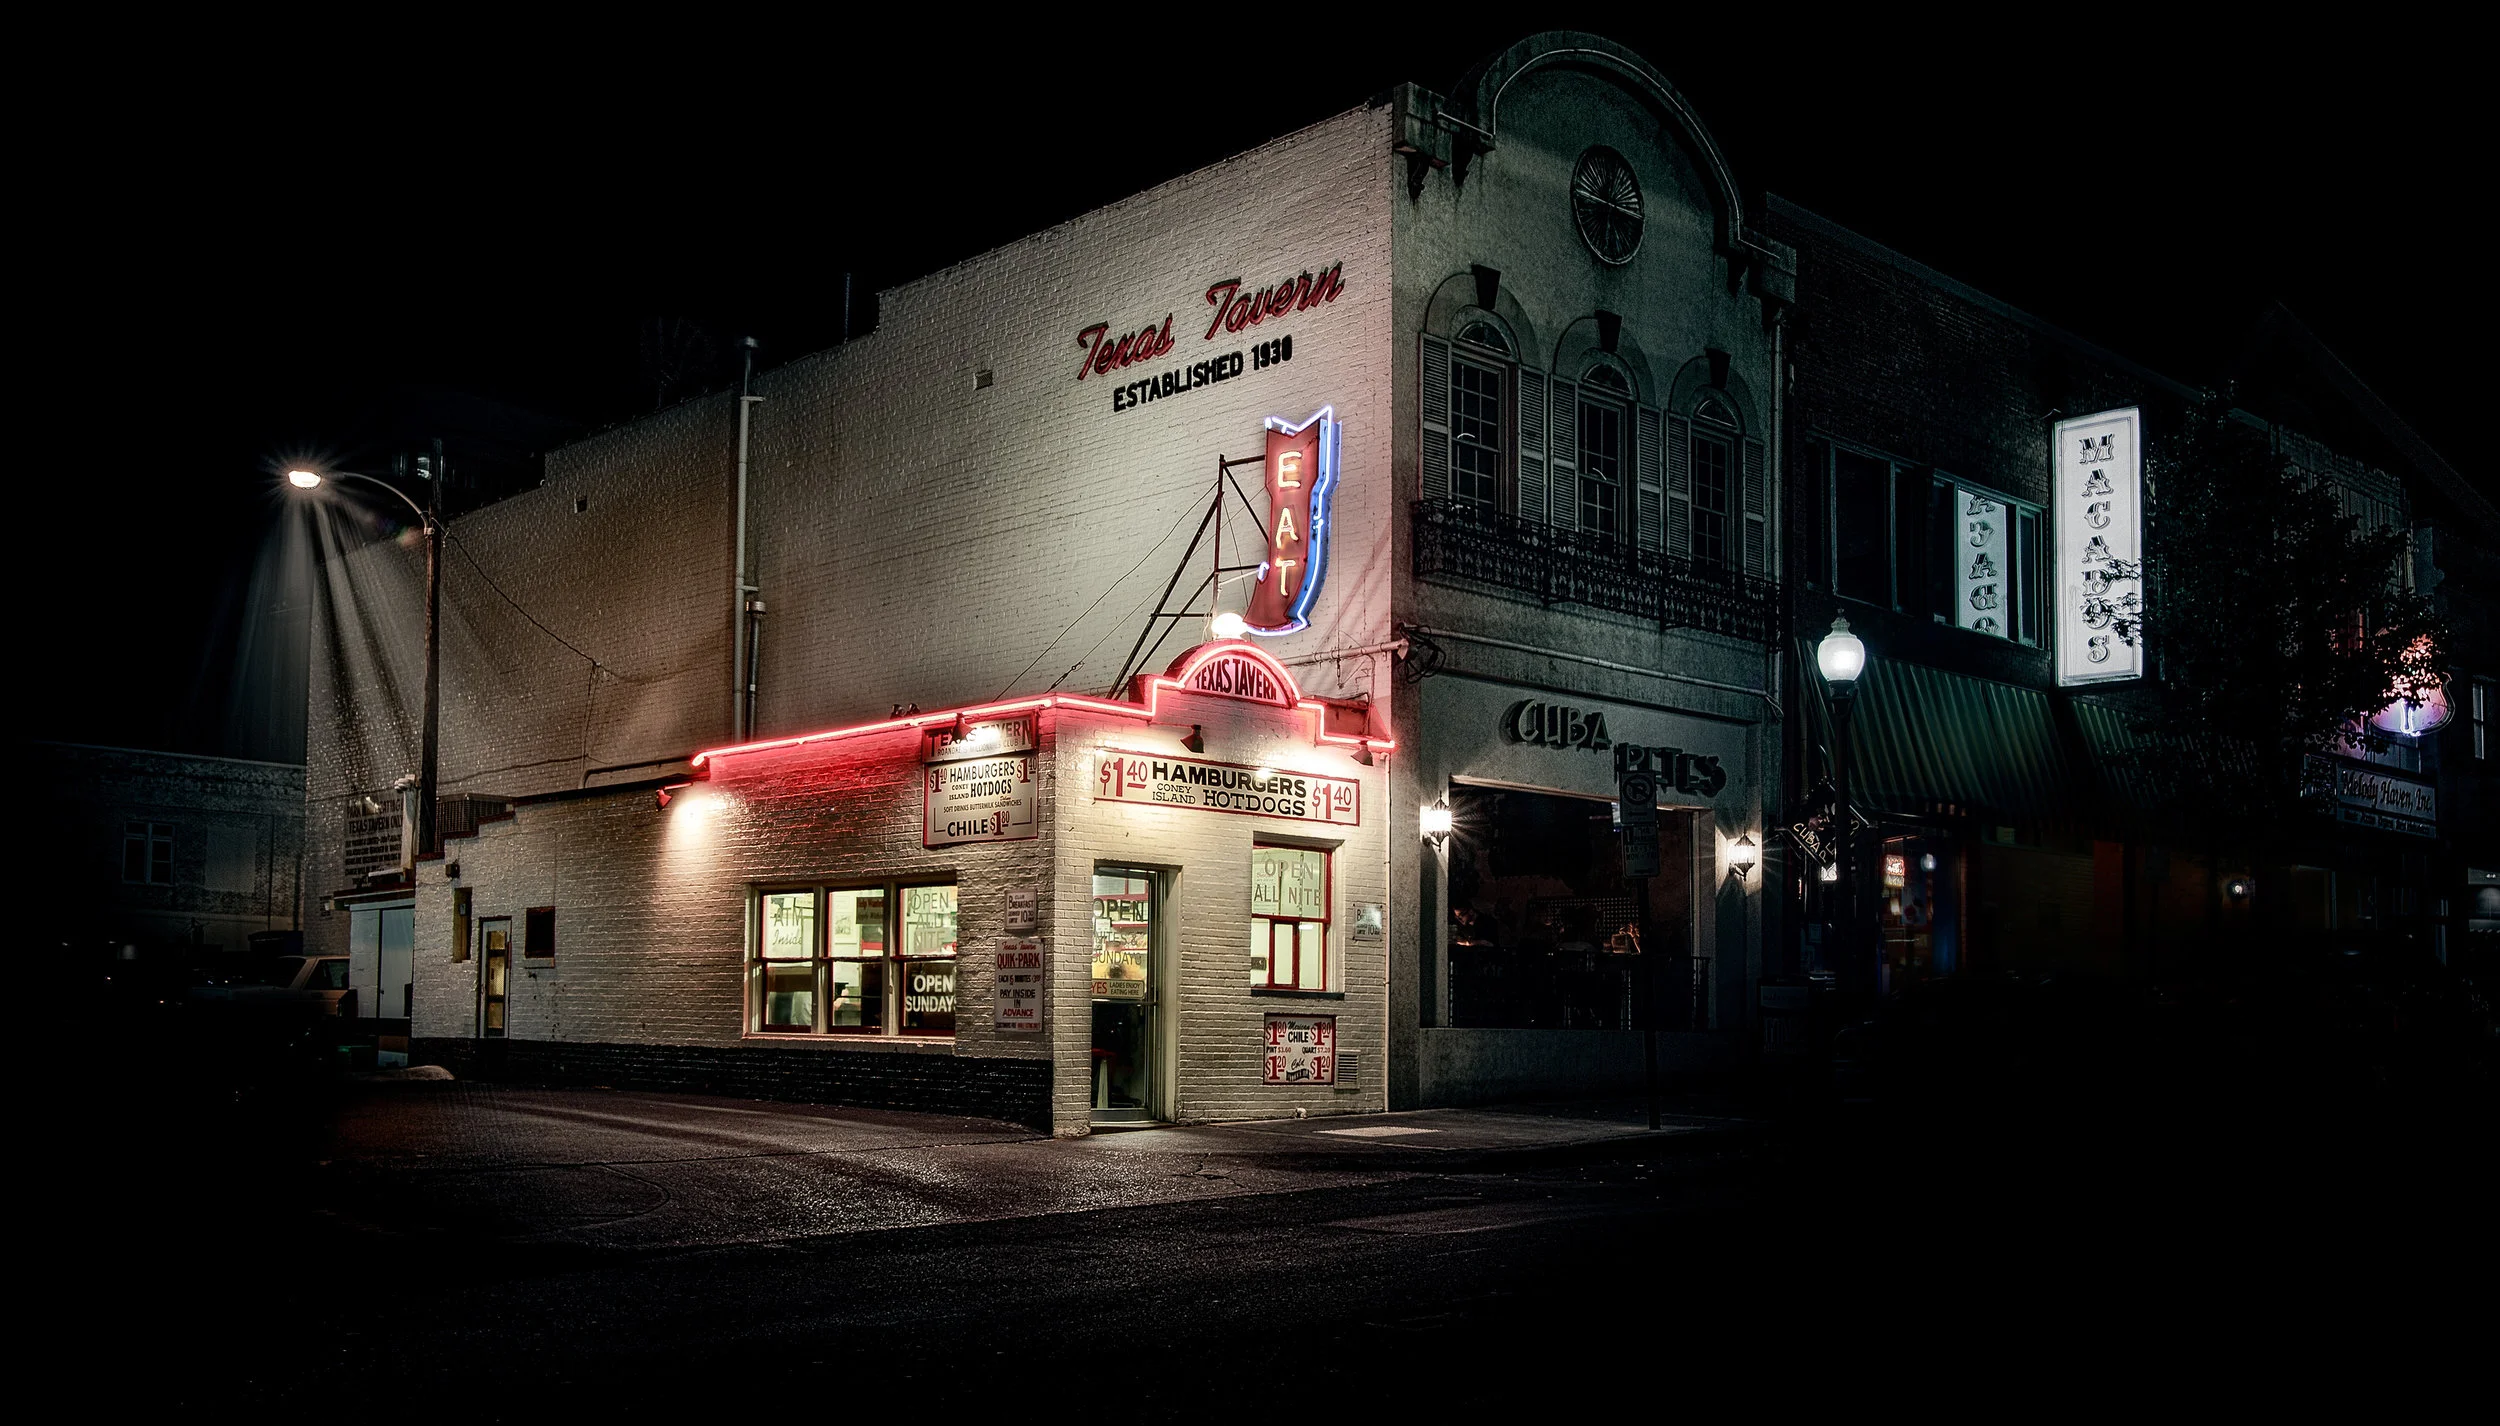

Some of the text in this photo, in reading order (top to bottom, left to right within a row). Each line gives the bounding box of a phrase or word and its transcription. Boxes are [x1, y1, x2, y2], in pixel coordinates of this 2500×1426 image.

[1077, 260, 1345, 380] Texas Tavern
[1113, 334, 1293, 412] ESTABLISHED 1930
[1275, 451, 1302, 598] EAT
[1195, 659, 1277, 700] TEXAS TAVERN
[1508, 698, 1613, 752] CUBA
[950, 760, 1015, 783] HAMBURGERS
[1152, 761, 1306, 798] HAMBURGERS
[952, 783, 969, 791] CONEY
[1157, 783, 1193, 794] CONEY
[943, 799, 1022, 813] SOFT DRINKS BUTTERMILK SANDWICHES
[949, 793, 970, 801] ISLAND
[1152, 791, 1196, 805] ISLAND
[947, 819, 988, 837] CHILE
[1793, 822, 1820, 853] CUBA
[1265, 858, 1314, 881] OPEN
[911, 891, 949, 911] OPEN
[1253, 884, 1279, 902] ALL
[774, 907, 803, 927] ATM
[1093, 898, 1145, 922] OPEN
[914, 974, 953, 993] OPEN
[1091, 981, 1107, 994] YES
[1000, 989, 1036, 998] PAY INSIDE
[1002, 1008, 1034, 1017] ADVANCE
[1014, 999, 1021, 1008] IN
[1287, 1021, 1310, 1030] Mexican
[1288, 1031, 1309, 1043] CHILE
[1302, 1046, 1317, 1055] QUART
